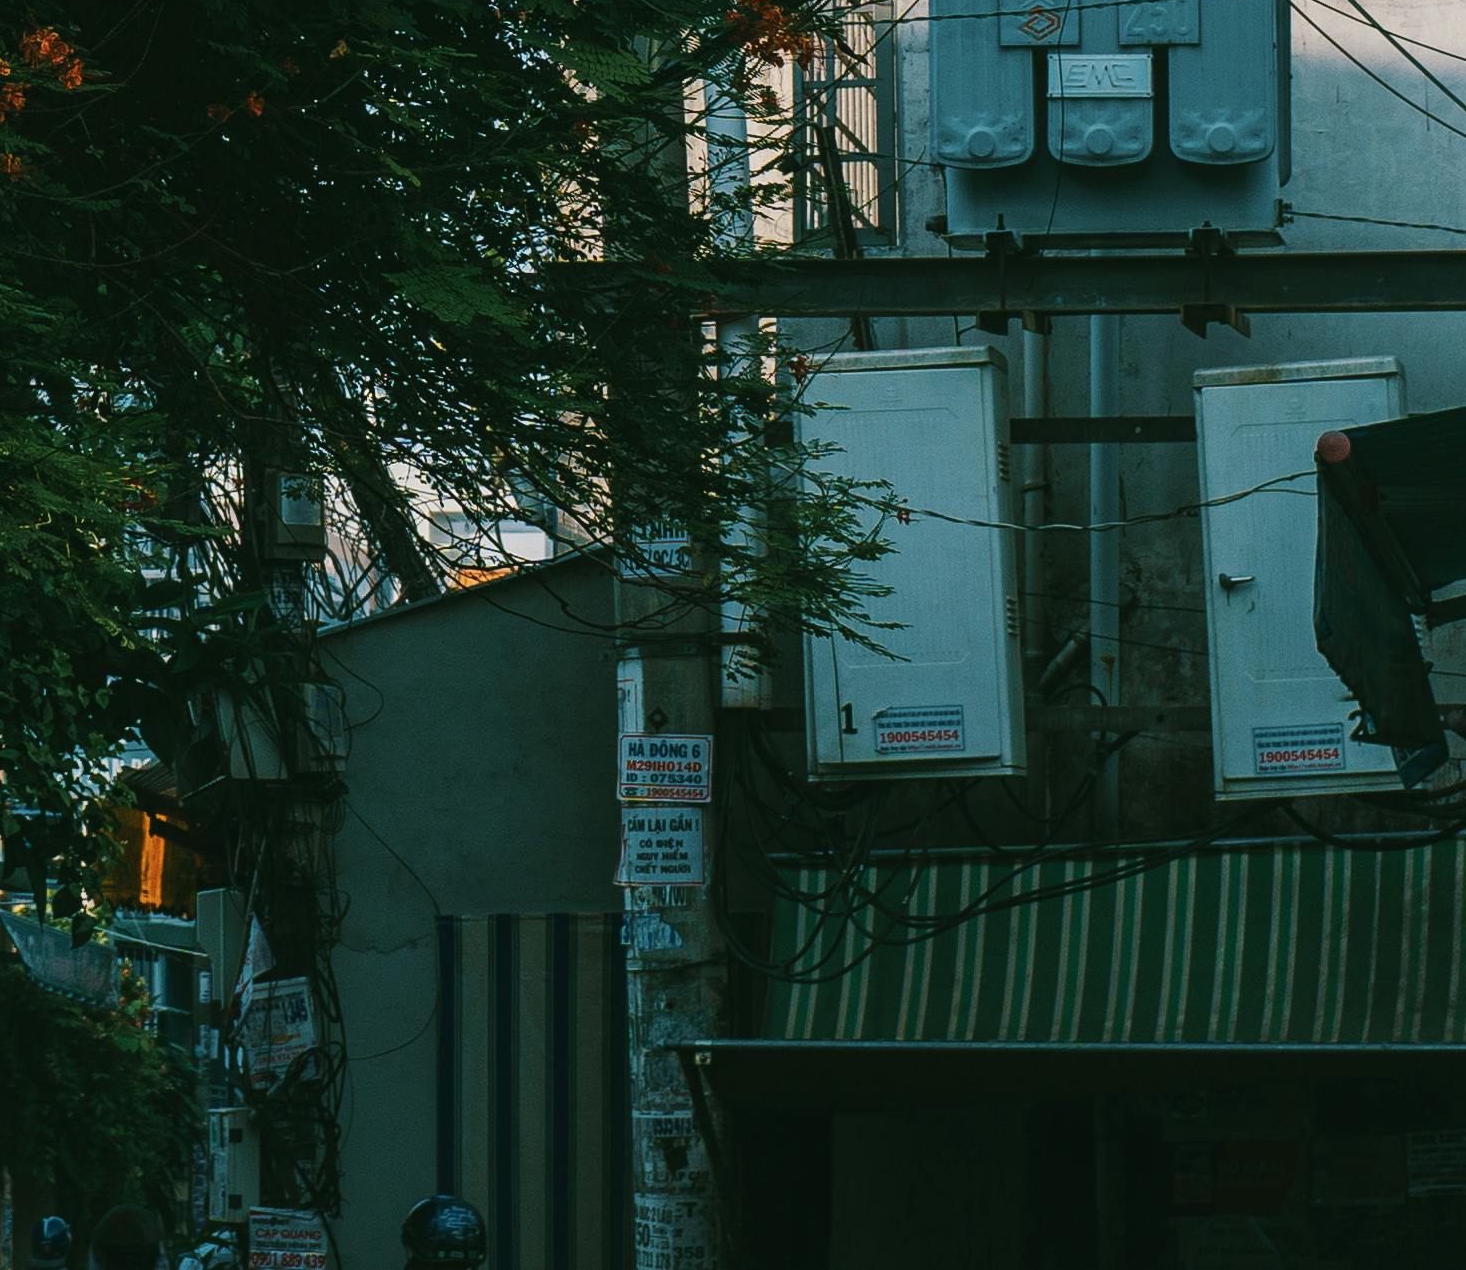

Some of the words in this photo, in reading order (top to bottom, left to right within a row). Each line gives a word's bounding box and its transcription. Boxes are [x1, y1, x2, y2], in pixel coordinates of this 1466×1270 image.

[841, 702, 858, 735] 1
[880, 729, 959, 744] 1900545454
[628, 739, 645, 757] HÀ
[649, 739, 688, 759] ĐÔNG
[691, 744, 701, 759] 6
[1259, 748, 1340, 764] 1900545454
[626, 773, 638, 783] ID
[650, 773, 703, 784] 075340
[647, 818, 667, 834] LẠI
